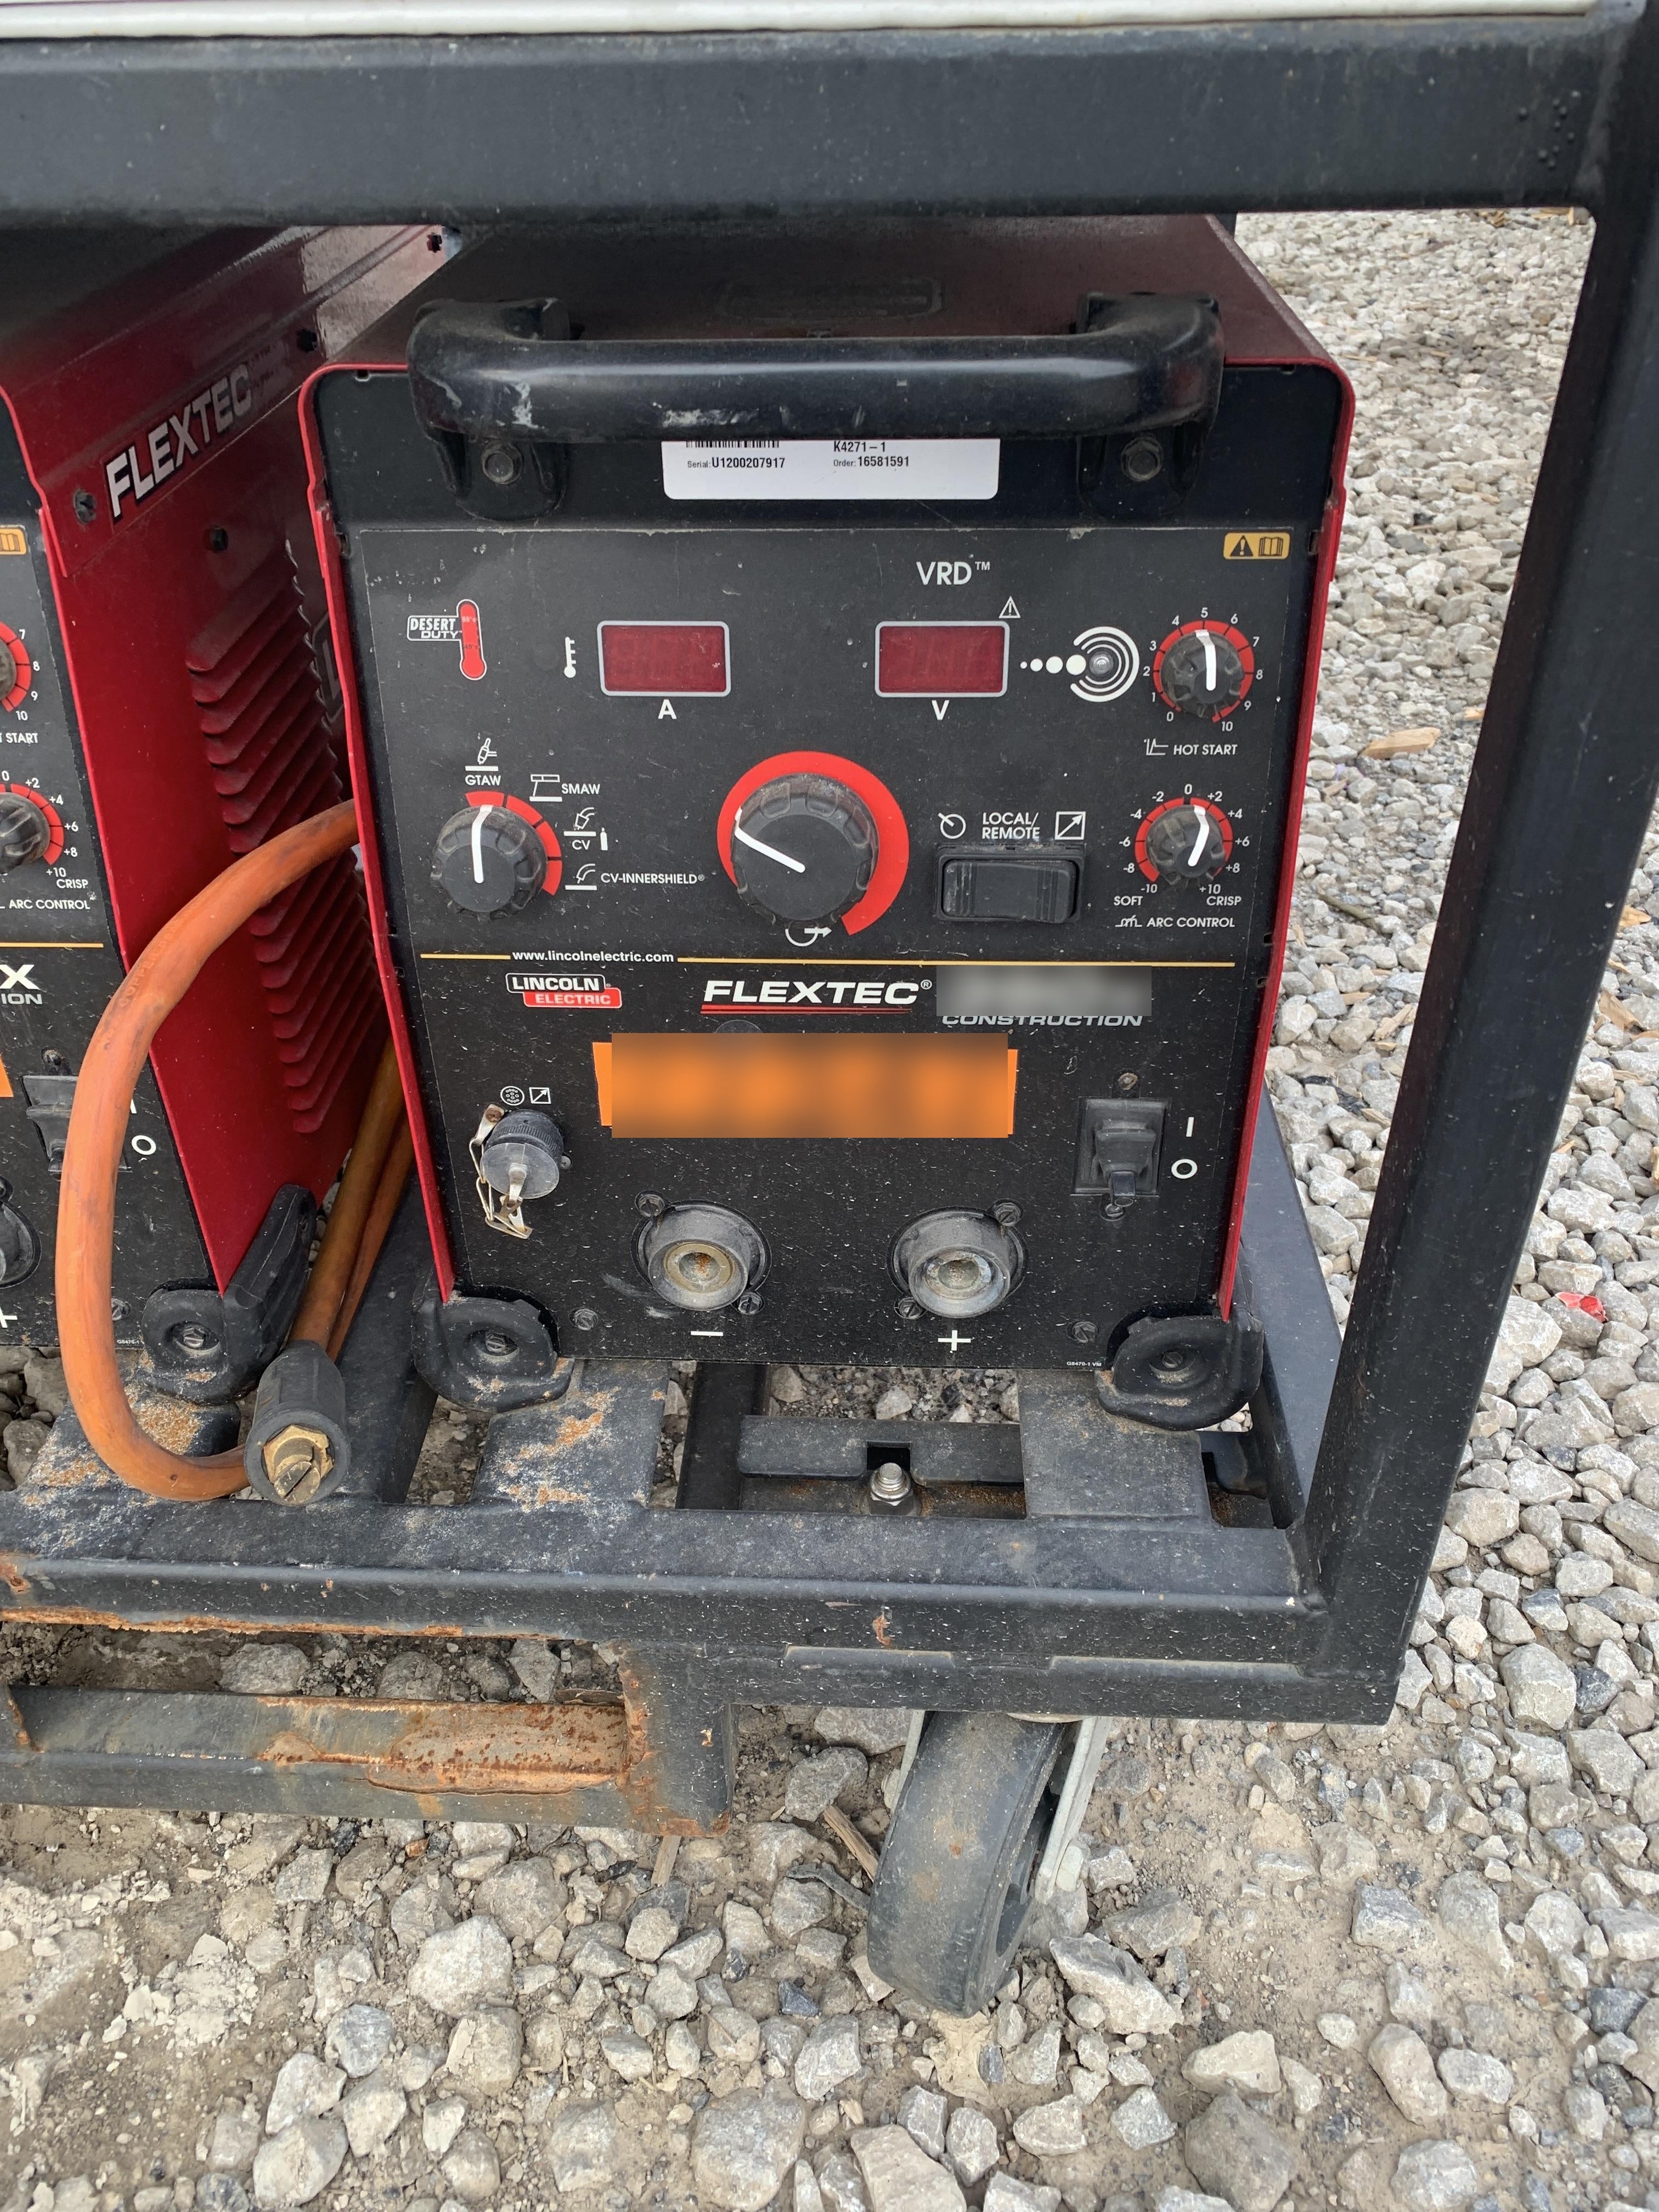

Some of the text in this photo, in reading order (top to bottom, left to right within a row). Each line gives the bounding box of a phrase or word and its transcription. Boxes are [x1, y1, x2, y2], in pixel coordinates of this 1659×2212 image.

[106, 364, 252, 517] FLEXTEC
[1201, 607, 1208, 618] 5
[410, 618, 456, 630] DESERT
[1172, 616, 1179, 625] 4
[1231, 614, 1238, 624] 6
[19, 629, 25, 639] 7
[1150, 641, 1156, 651] 3
[1253, 636, 1259, 646] 7
[33, 661, 40, 671] 8
[1143, 666, 1150, 676] 2
[1256, 669, 1263, 680] 8
[31, 691, 38, 701] 9
[1152, 692, 1155, 702] 1
[658, 699, 676, 719] A
[932, 700, 949, 720] V
[1244, 701, 1251, 710] 9
[16, 711, 27, 720] 10
[1167, 712, 1173, 721] 0
[1222, 721, 1233, 731] 10
[6, 733, 38, 744] START
[1173, 744, 1237, 755] HOT START
[2, 771, 9, 781] 0
[465, 775, 501, 786] GTAW
[26, 777, 40, 788] +2
[562, 783, 600, 794] SMAW
[1184, 784, 1192, 794] 0
[49, 795, 63, 805] +4
[1152, 791, 1164, 802] -2
[1207, 791, 1222, 802] +2
[1131, 809, 1142, 819] -4
[1228, 809, 1242, 819] +4
[983, 812, 1039, 827] LOCAL/
[65, 822, 78, 832] +6
[982, 827, 1040, 839] REMOTE
[572, 840, 590, 850] CV
[1119, 837, 1130, 847] -6
[1235, 836, 1249, 847] +6
[64, 847, 77, 857] +8
[46, 867, 66, 877] +10
[1124, 863, 1135, 873] -8
[1226, 863, 1240, 873] +8
[57, 879, 88, 888] CRISP
[1141, 884, 1157, 893] -10
[1200, 884, 1221, 894] +10
[9, 900, 90, 909] ARC CONTROL
[1114, 896, 1143, 905] SOFT
[1206, 896, 1241, 905] CRISP
[1147, 917, 1234, 927] ARC CONTROL
[512, 951, 674, 962] www.lincolnelectric.com
[512, 977, 599, 990] LINCOLN
[535, 994, 611, 1005] ELECTRIC
